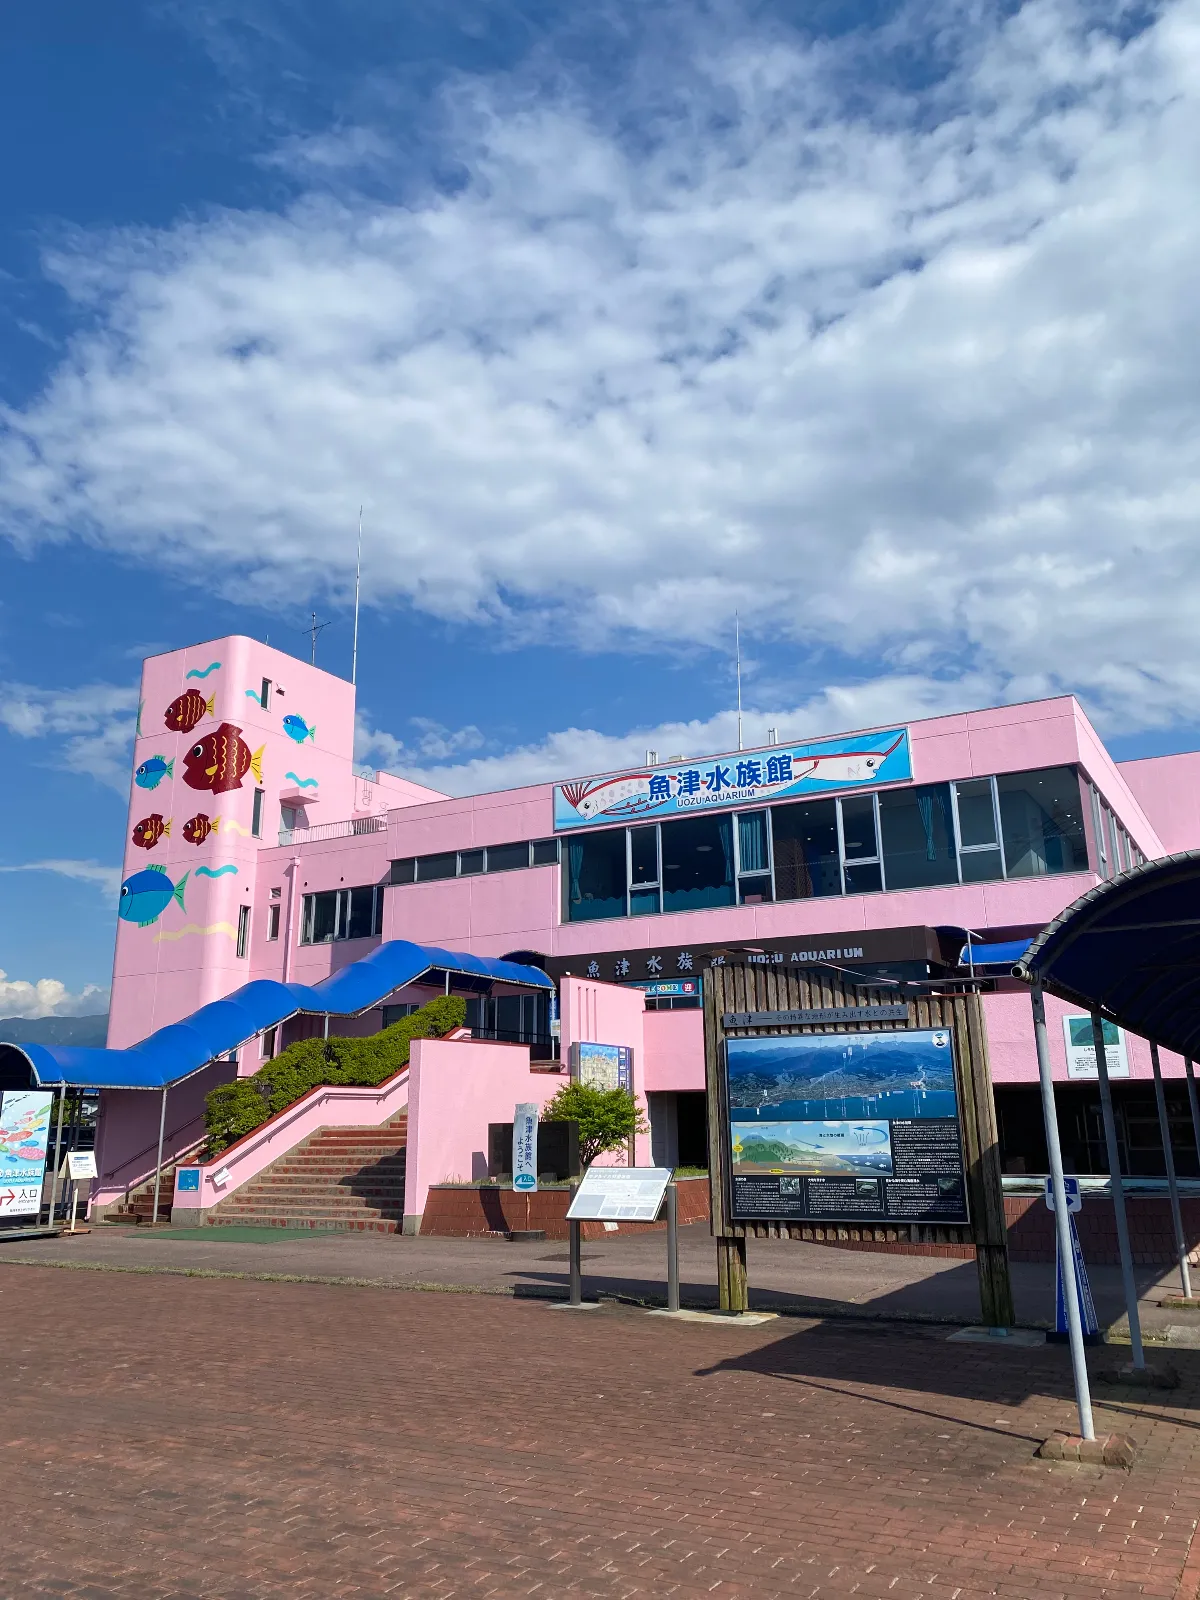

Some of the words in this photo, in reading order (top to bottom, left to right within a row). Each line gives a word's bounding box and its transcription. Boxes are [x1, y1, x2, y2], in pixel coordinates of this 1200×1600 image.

[648, 754, 793, 801] 魚津水族館
[677, 797, 702, 807] UOZU
[704, 788, 755, 804] AQUARIUM
[790, 947, 864, 962] AQUARIUM
[525, 1116, 533, 1168] 魚津水族館へ
[19, 1189, 38, 1199] 入口
